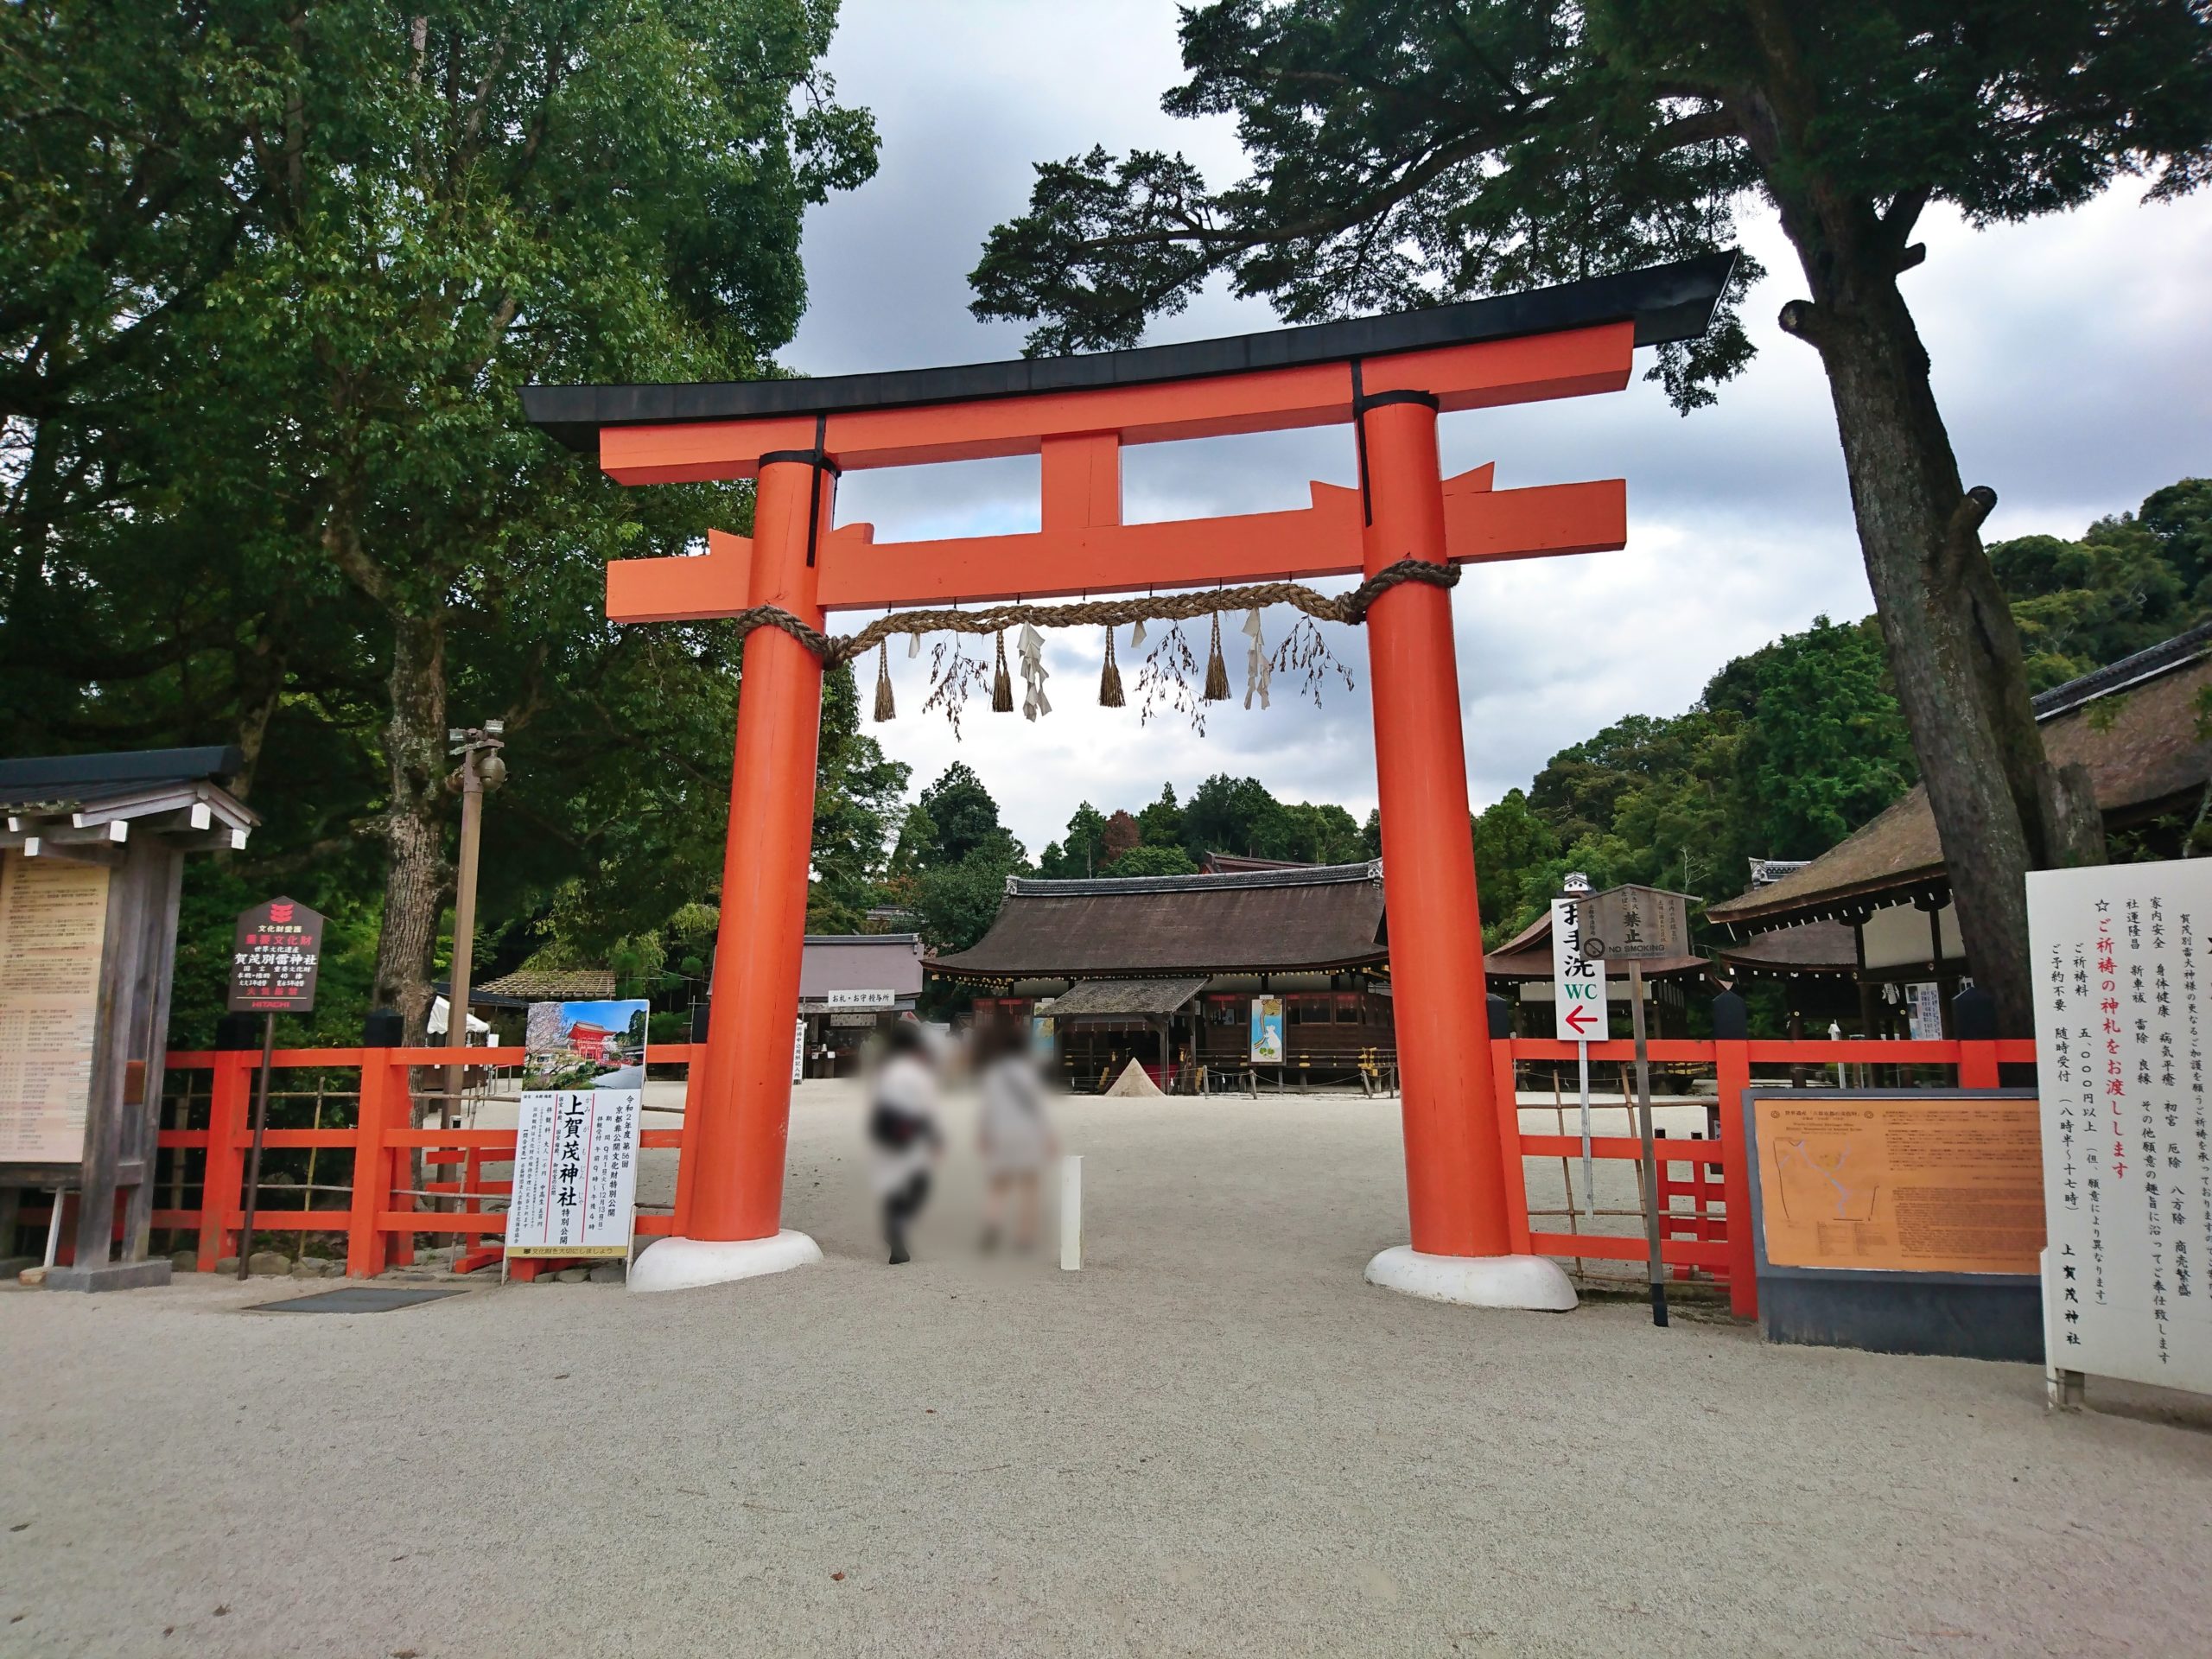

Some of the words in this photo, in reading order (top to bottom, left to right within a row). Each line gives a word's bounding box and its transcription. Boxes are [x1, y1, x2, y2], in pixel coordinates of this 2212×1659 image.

[245, 934, 313, 945] 重要文化財
[1624, 911, 1643, 944] 禁止
[2126, 898, 2141, 950] 社運隆昌
[2149, 896, 2166, 949] 家内安全
[234, 952, 318, 966] 賀茂別雷神社
[1624, 944, 1665, 952] SMOKING
[2050, 942, 2067, 1012] ご予約不要
[2073, 942, 2088, 997] ご祈祷料
[2130, 964, 2146, 1004] 新車祓
[2155, 963, 2171, 1017] 身体健康
[1564, 983, 1598, 1000] WC
[2134, 1018, 2149, 1045] 雷除
[2055, 1027, 2071, 1083] 随時受付
[2137, 1058, 2152, 1085] 良縁
[2158, 1032, 2177, 1087] 病気平癒
[623, 1095, 634, 1139] 令和2年度
[2164, 1100, 2178, 1127] 初宮
[556, 1094, 585, 1207] 上賀茂神社
[621, 1141, 631, 1168] 第56回
[2168, 1142, 2182, 1169] 厄除
[2170, 1185, 2187, 1226] 八方除
[2175, 1240, 2191, 1298] 商売繁盛
[2062, 1243, 2081, 1345] 上賀茂神社
